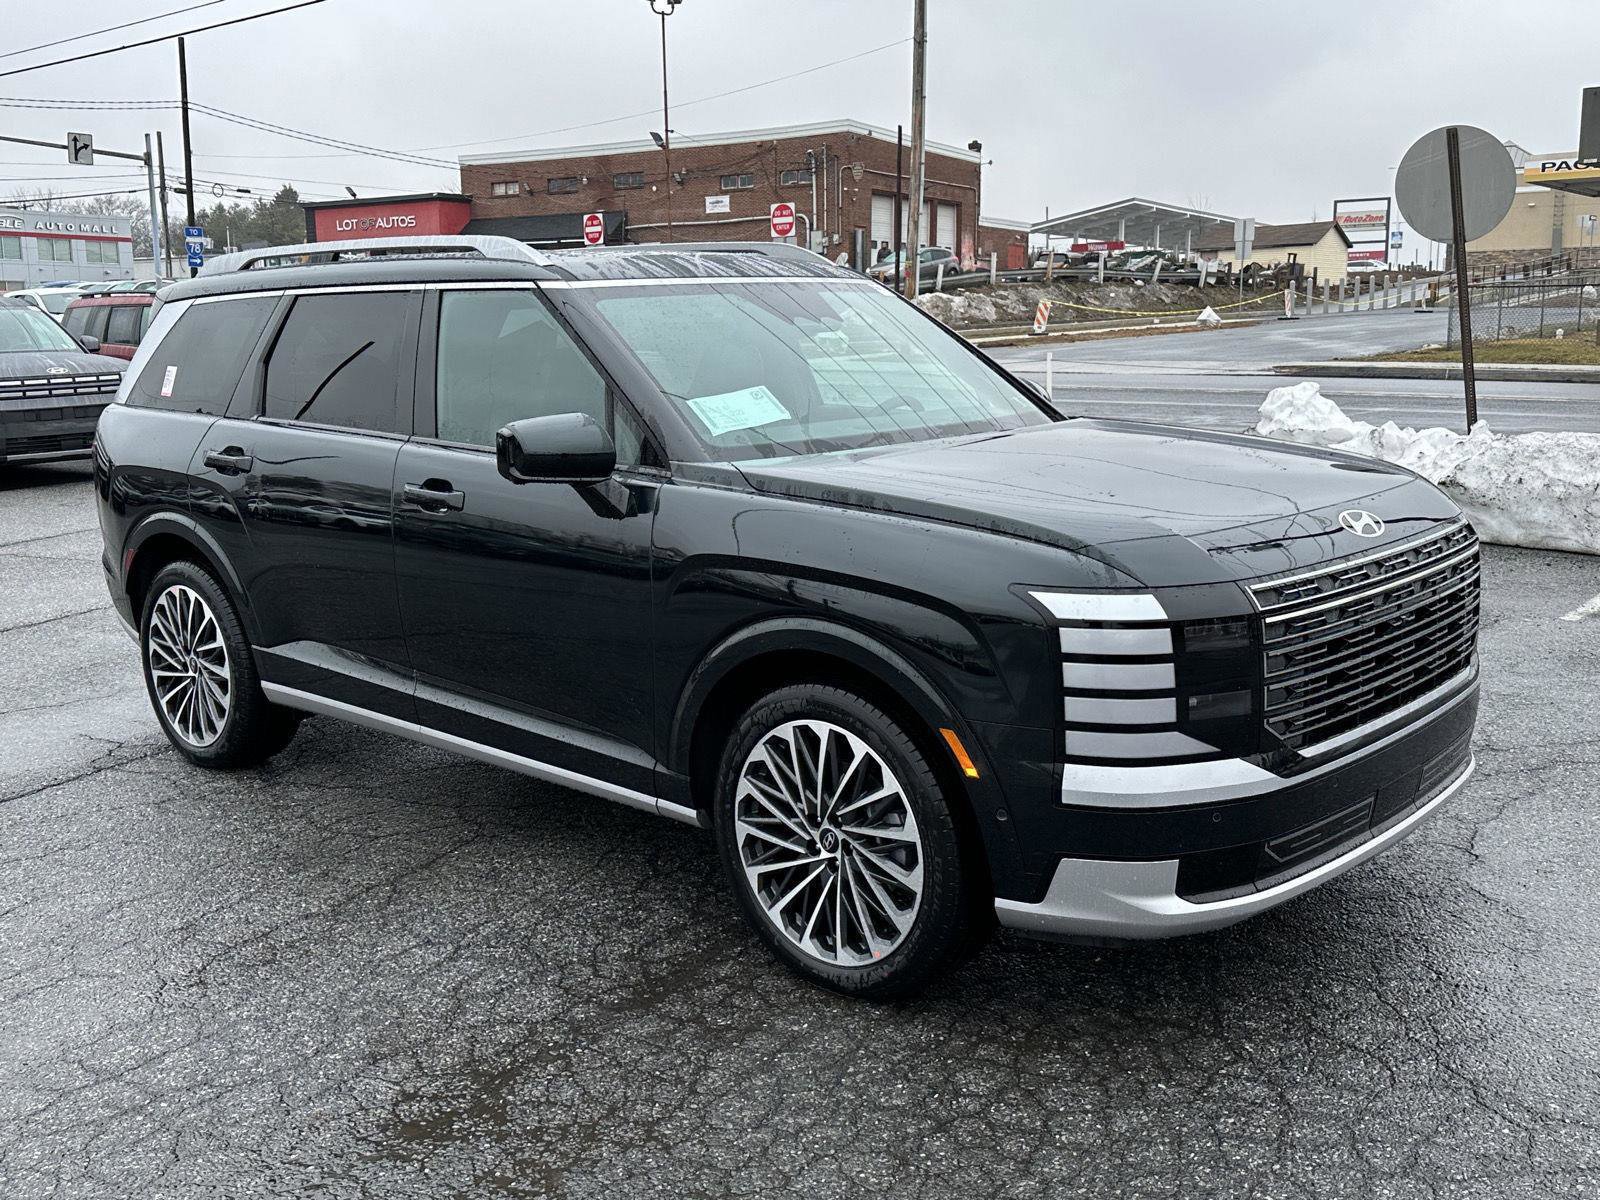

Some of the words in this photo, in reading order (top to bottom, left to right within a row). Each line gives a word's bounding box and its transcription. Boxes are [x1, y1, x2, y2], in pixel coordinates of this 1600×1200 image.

[336, 219, 358, 231] LOT
[375, 215, 416, 229] AUTOS
[1343, 214, 1384, 223] AutoZone
[35, 220, 75, 231] AUTO
[80, 223, 119, 234] MALL
[189, 228, 199, 236] TO
[189, 243, 201, 254] 78
